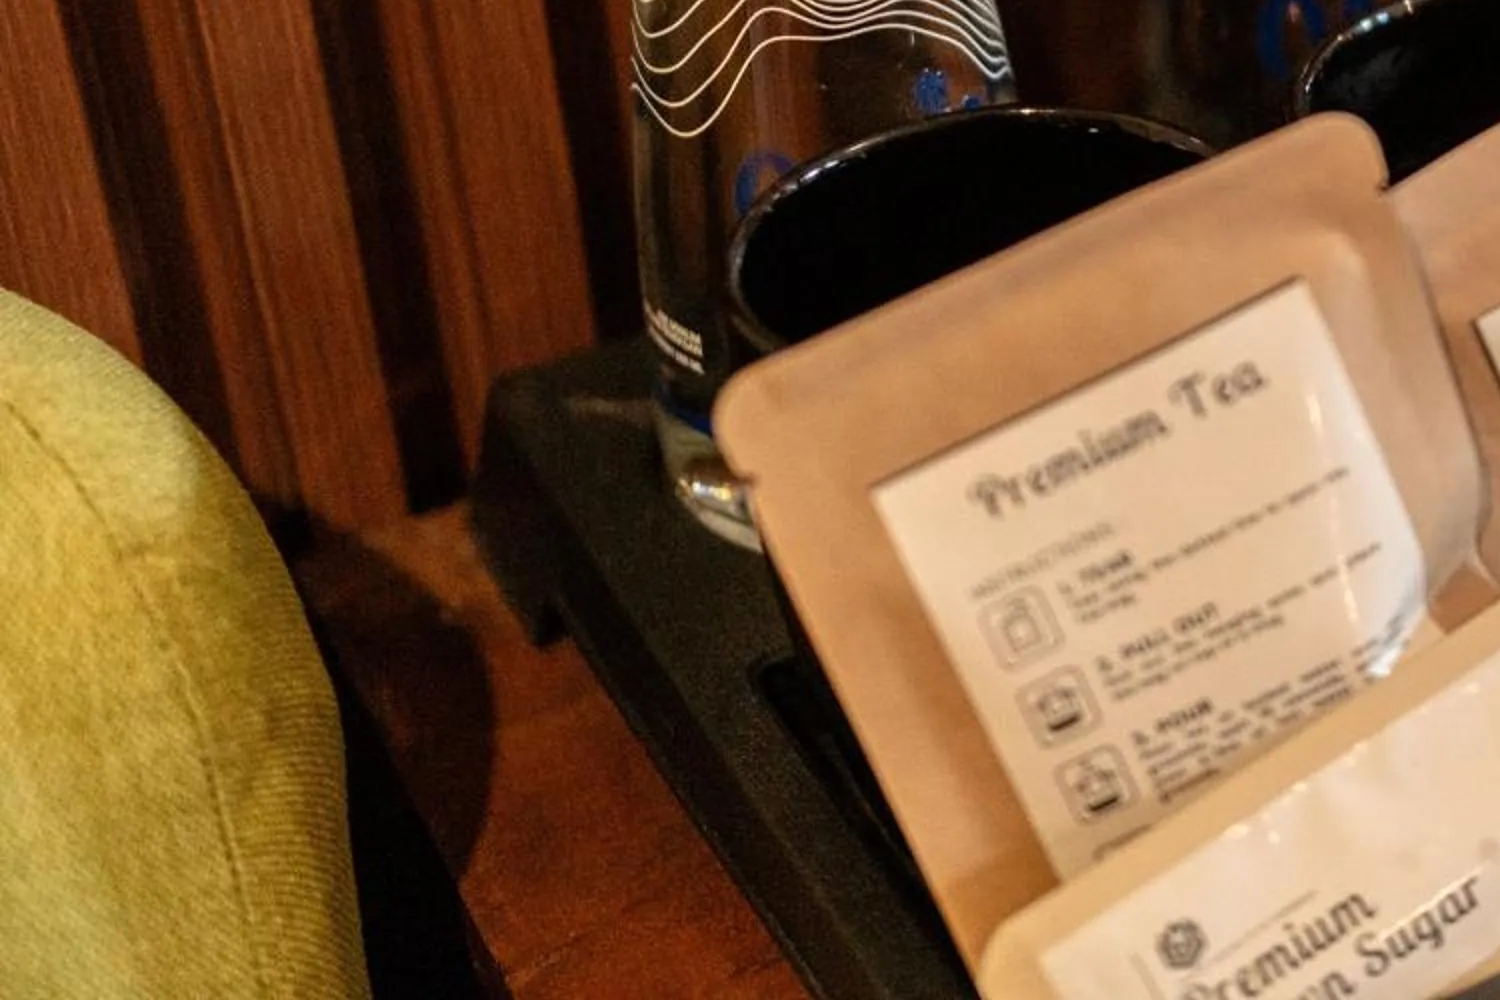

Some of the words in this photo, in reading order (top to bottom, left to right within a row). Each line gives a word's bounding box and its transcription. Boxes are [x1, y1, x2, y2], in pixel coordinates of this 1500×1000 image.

[965, 409, 1170, 520] Premium
[1166, 359, 1268, 420] Tea
[1353, 876, 1480, 977] Sugar
